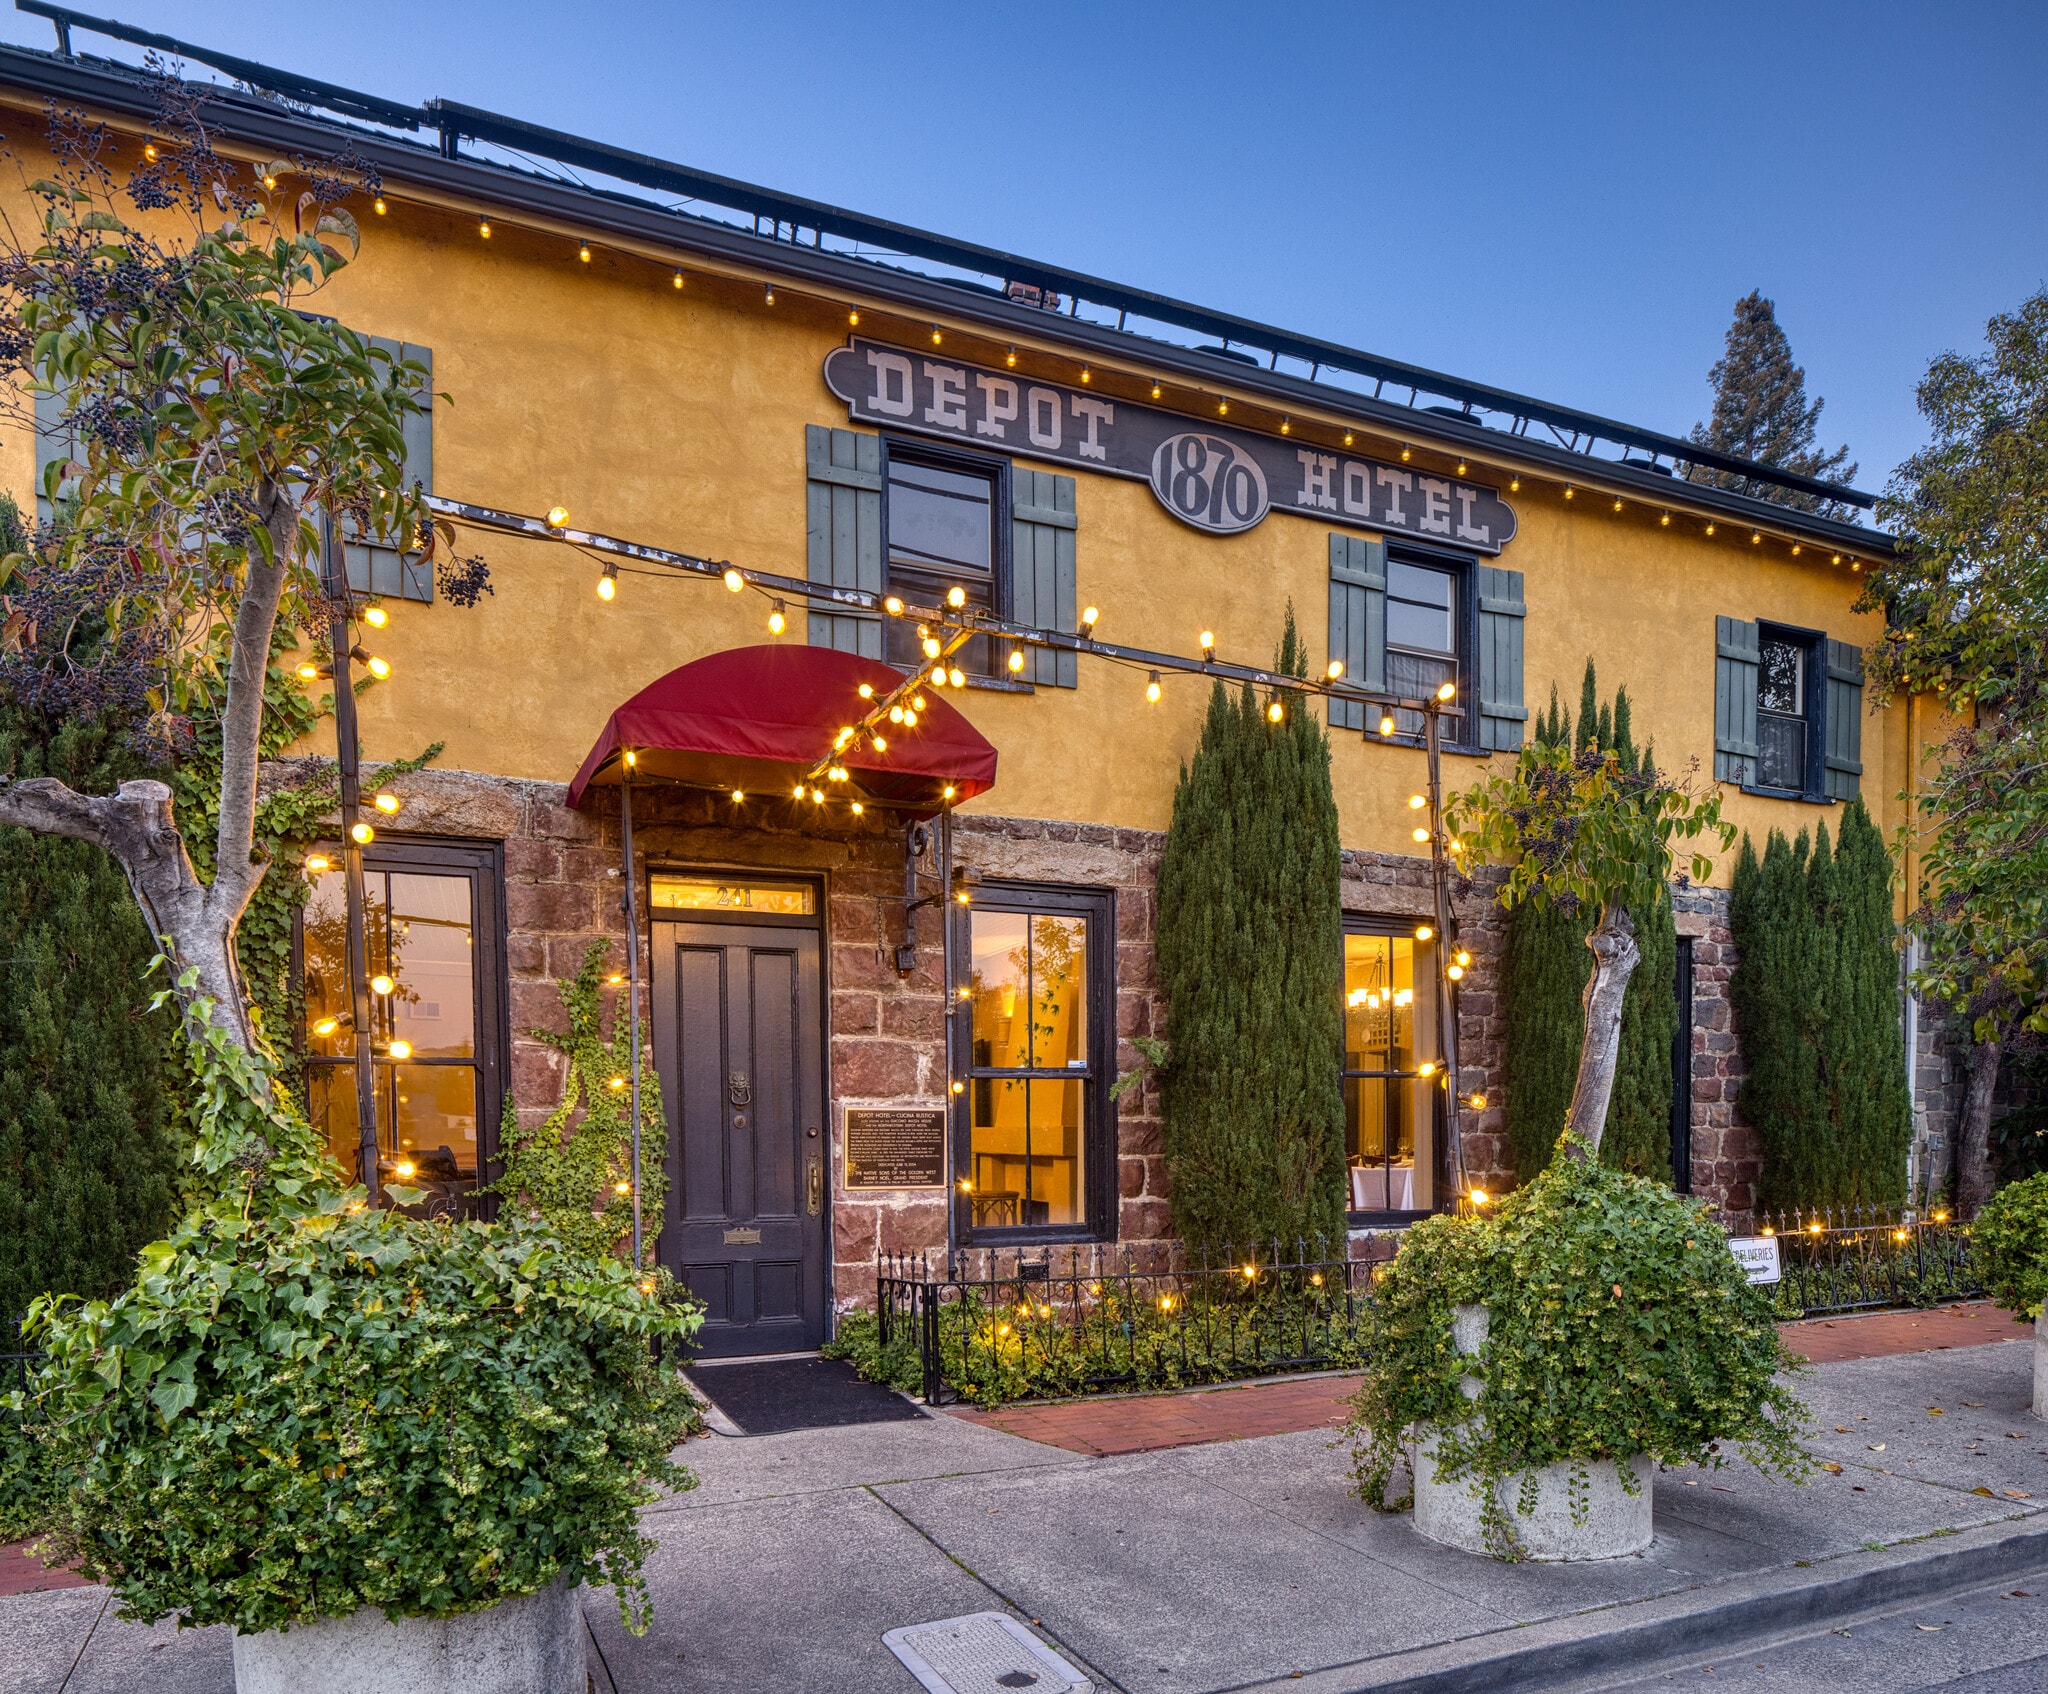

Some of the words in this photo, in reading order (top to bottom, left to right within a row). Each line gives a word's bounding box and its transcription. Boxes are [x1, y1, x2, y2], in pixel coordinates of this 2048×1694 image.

[867, 349, 1113, 461] DEPOT
[1160, 435, 1259, 524] 1870
[1297, 449, 1489, 543] HOTEL
[716, 886, 753, 907] 241
[1735, 1247, 1773, 1263] DELIVERIES
